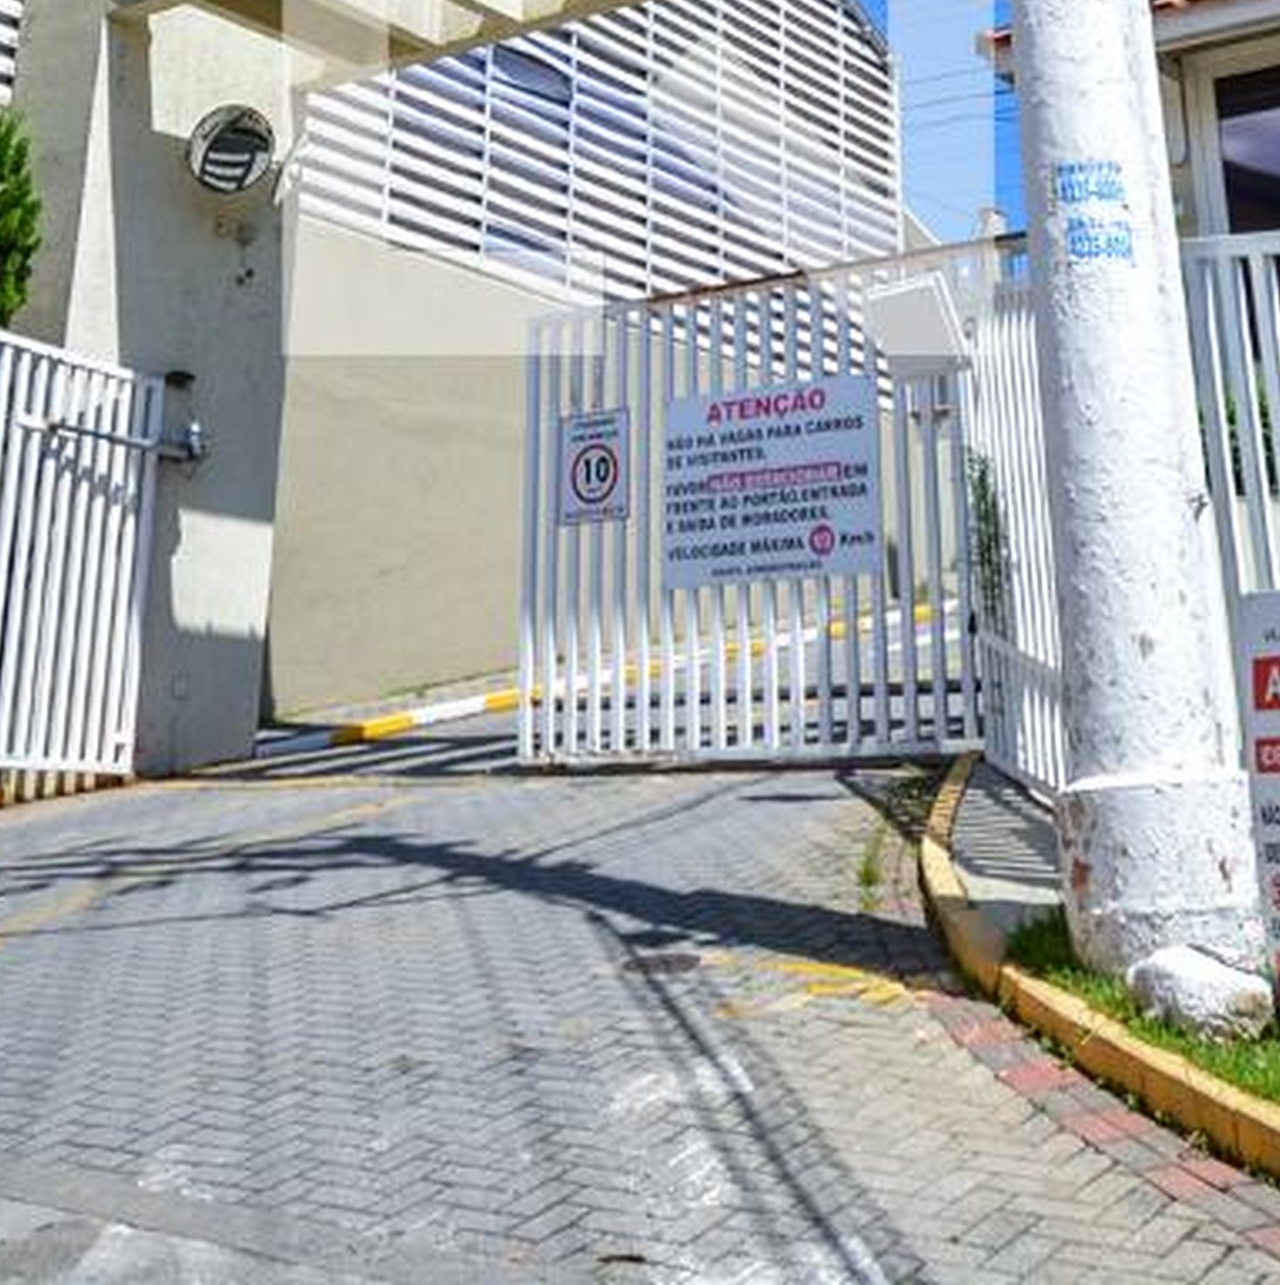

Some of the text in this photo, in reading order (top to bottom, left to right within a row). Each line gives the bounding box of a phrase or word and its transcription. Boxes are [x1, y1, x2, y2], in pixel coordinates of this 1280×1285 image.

[720, 427, 765, 445] VAGAS
[768, 423, 801, 440] PARA
[805, 416, 865, 434] CARROS
[584, 456, 610, 485] 10
[670, 541, 747, 562] VELOCIDADE
